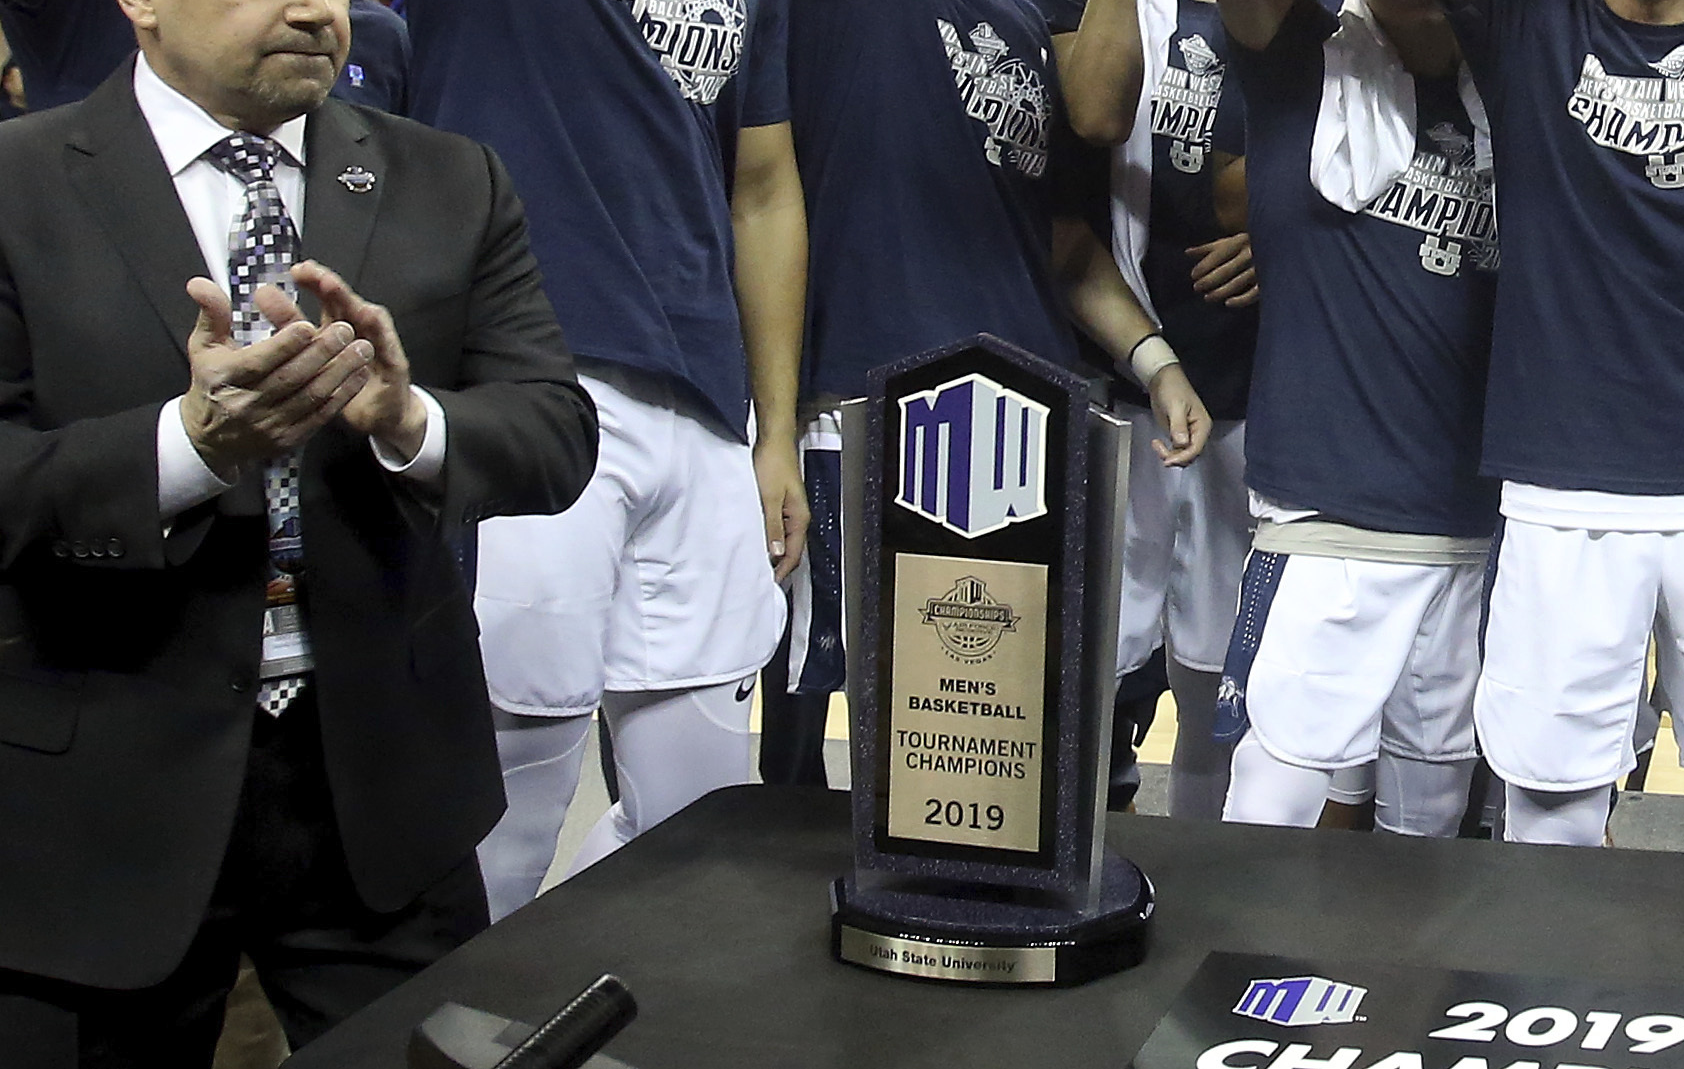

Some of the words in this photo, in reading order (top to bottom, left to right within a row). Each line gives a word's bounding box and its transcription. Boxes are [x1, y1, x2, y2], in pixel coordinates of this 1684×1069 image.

[1403, 166, 1477, 199] ASKETBALL
[940, 678, 996, 695] MEN'S
[908, 696, 1026, 720] BASKETBALL
[897, 730, 1037, 759] TOURNAMENT
[906, 752, 1026, 780] CHAMPIONS
[925, 798, 1005, 831] 2019
[870, 944, 898, 961] Utah
[901, 950, 937, 967] State
